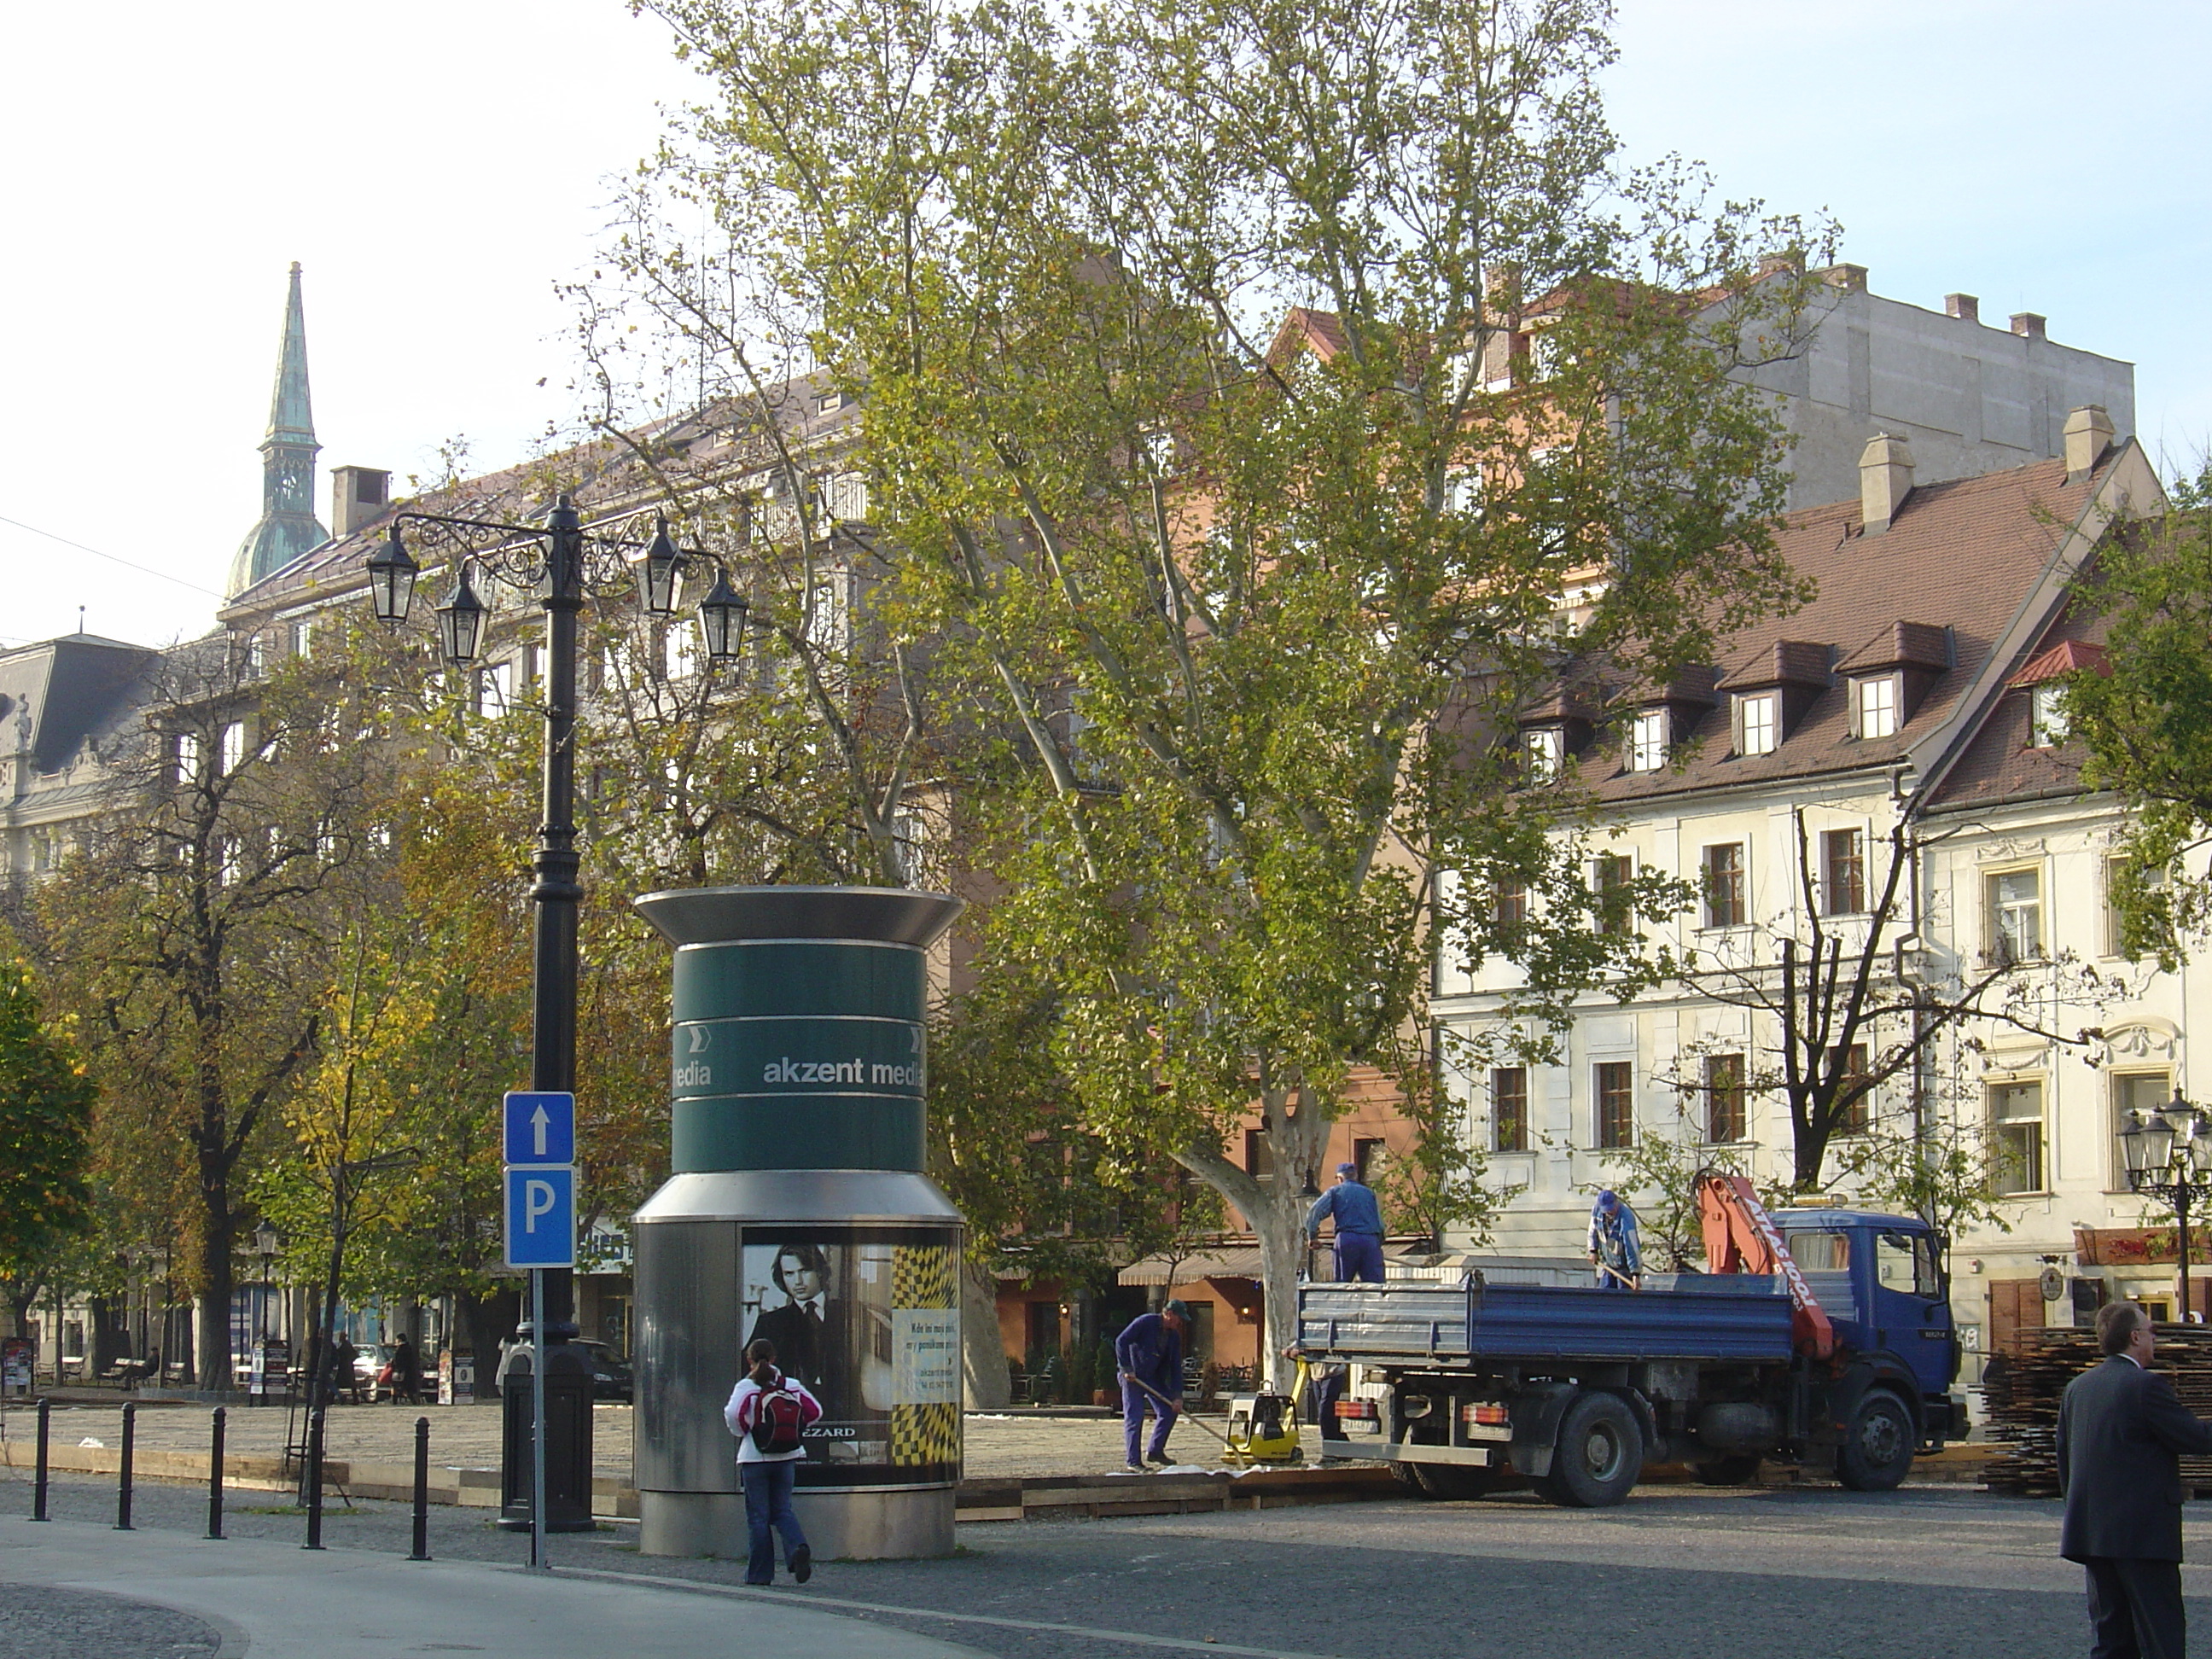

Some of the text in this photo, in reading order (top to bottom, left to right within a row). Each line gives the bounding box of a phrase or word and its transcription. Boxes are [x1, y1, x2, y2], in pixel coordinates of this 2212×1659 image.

[763, 1057, 923, 1087] akzent media
[526, 1179, 556, 1233] P
[1744, 1197, 1818, 1307] ATLAS 100.1
[802, 1428, 856, 1438] EZARD
